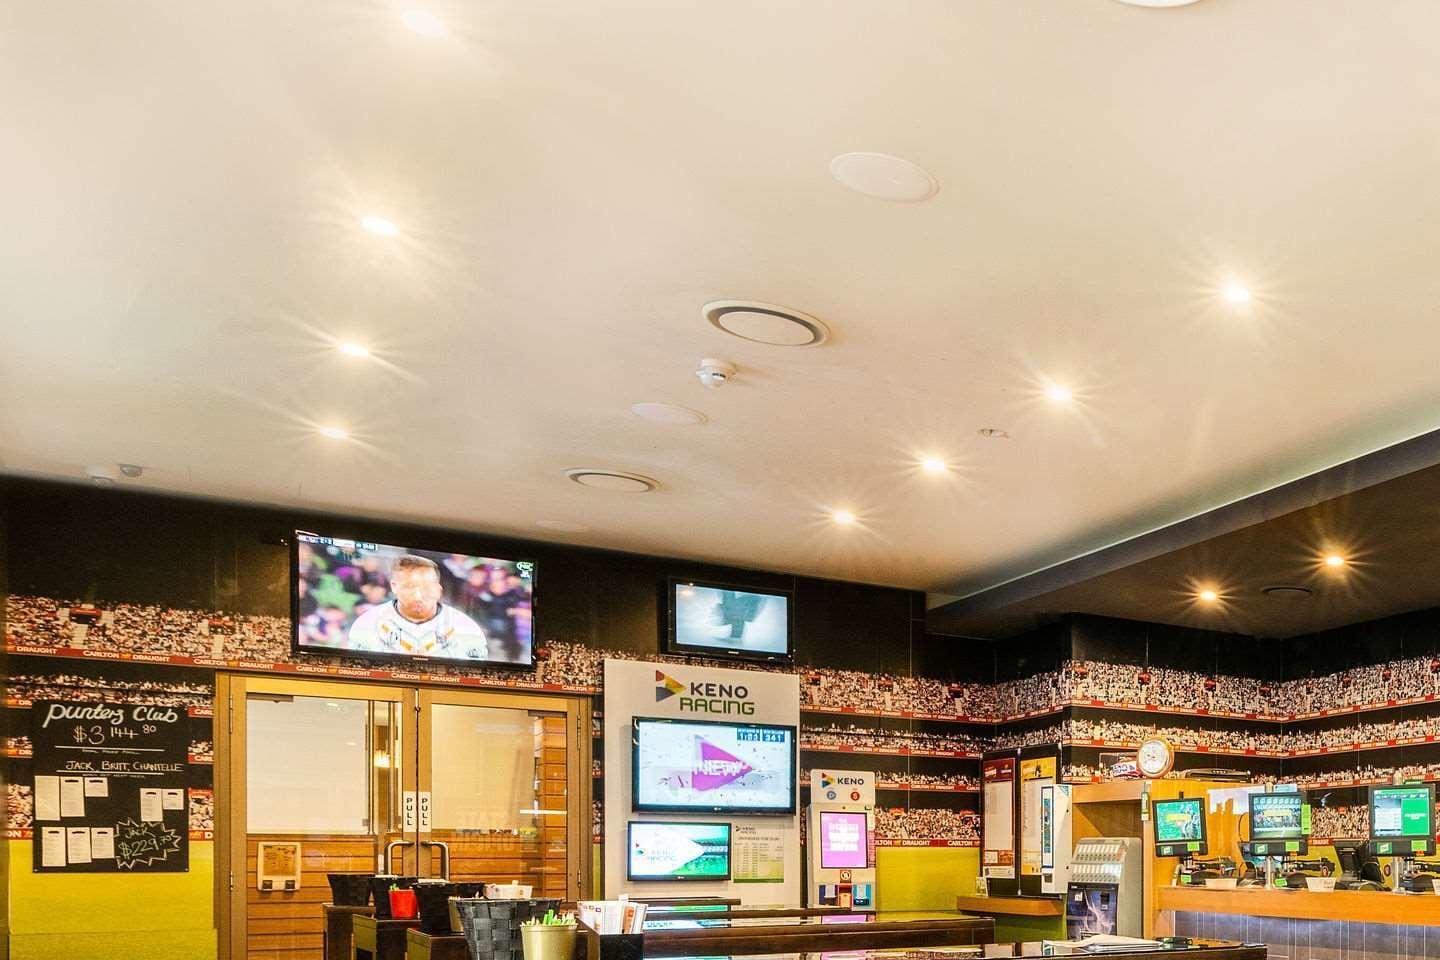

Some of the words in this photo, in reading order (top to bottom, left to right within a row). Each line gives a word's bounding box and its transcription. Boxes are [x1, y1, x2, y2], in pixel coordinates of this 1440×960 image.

[16, 646, 58, 655] DRAUGHT
[82, 649, 120, 658] CARLTON
[132, 654, 171, 663] DRAUGHT
[193, 658, 228, 666] CARLTON
[239, 661, 275, 670] DRAUGHT
[296, 665, 328, 673] CARLTON
[338, 668, 371, 677] DRAUGHT
[391, 672, 421, 681] CARLTON
[430, 674, 461, 683] DRAUGHT
[516, 681, 545, 689] DRAUGHT
[690, 682, 748, 698] KENO
[679, 697, 755, 715] RACING
[132, 705, 179, 723] Club
[837, 777, 865, 785] KENO
